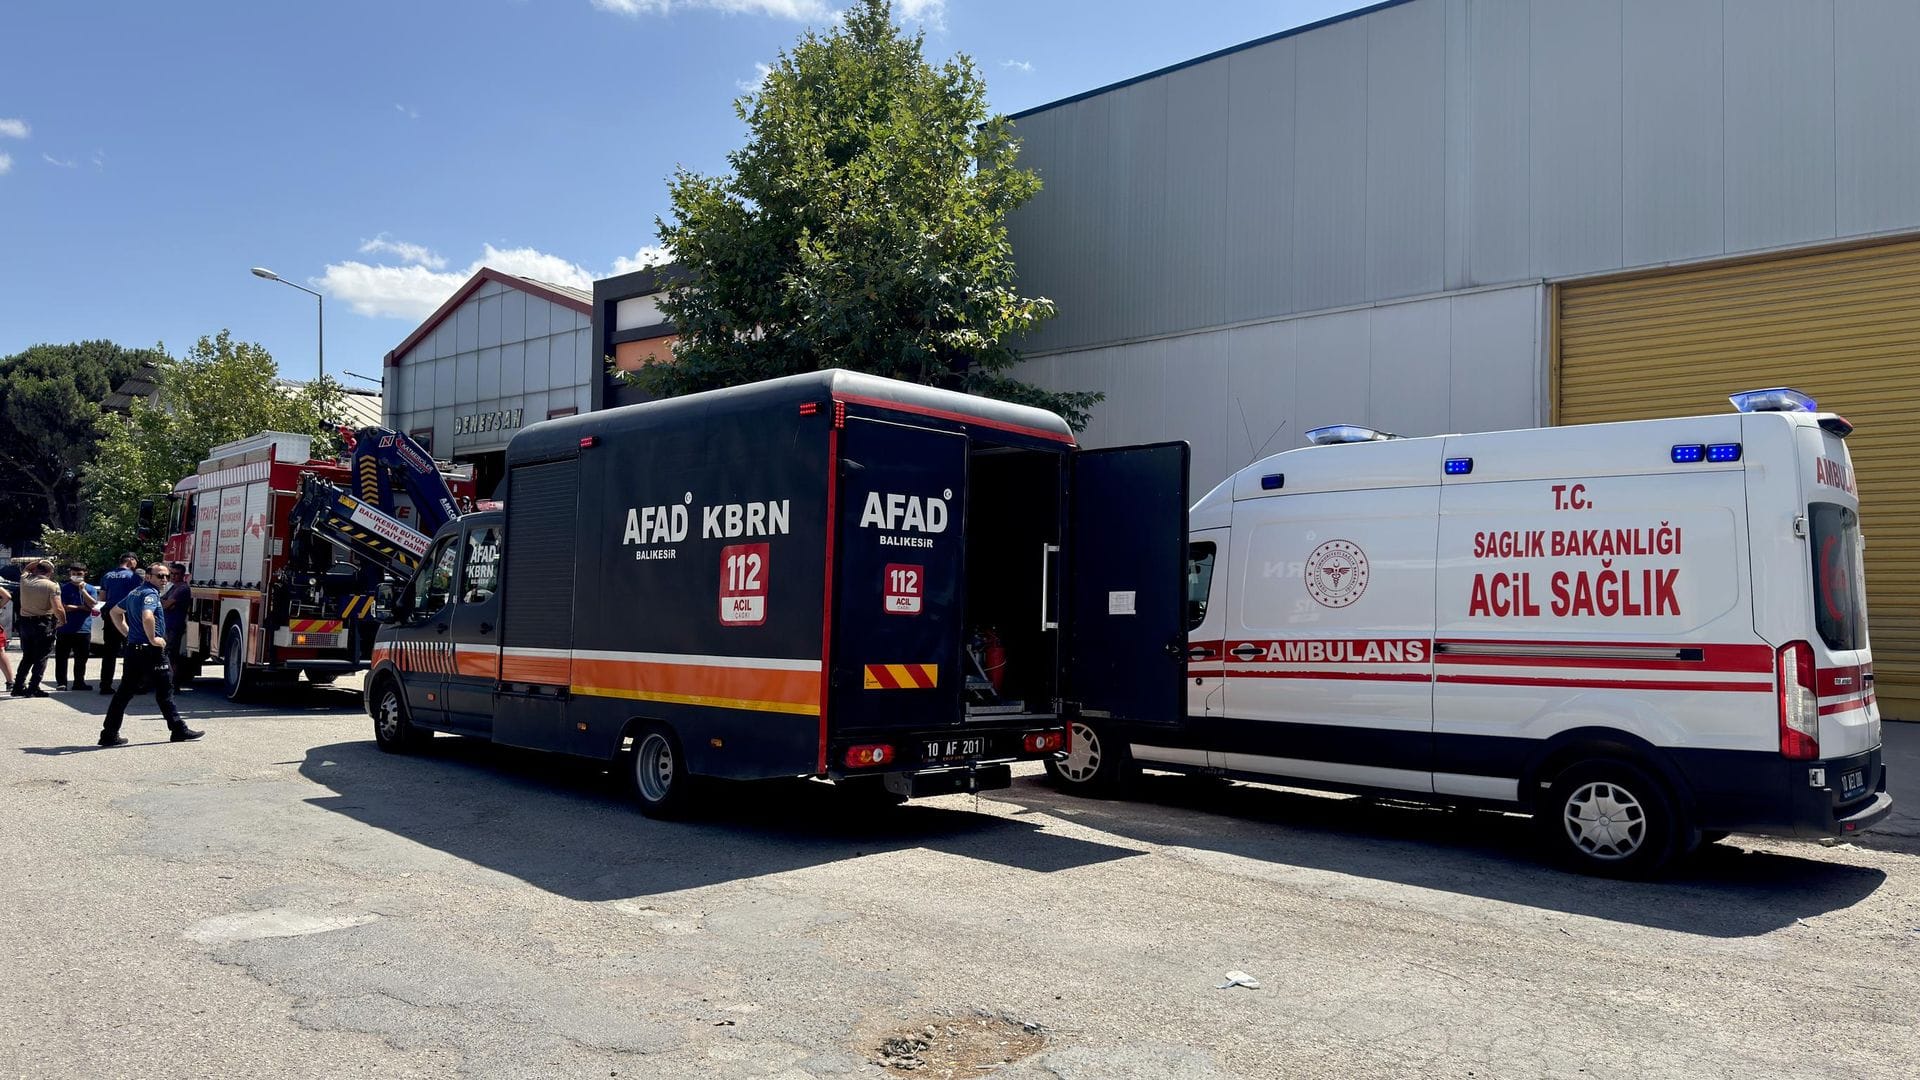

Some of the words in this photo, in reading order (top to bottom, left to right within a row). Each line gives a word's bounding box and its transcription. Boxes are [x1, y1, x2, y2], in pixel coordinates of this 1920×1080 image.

[454, 408, 523, 436] DENEYSAN
[1552, 484, 1592, 510] T.C.
[623, 504, 689, 545] AFAD
[702, 499, 790, 539] KBRN
[860, 491, 948, 533] AFAD
[1551, 521, 1681, 557] BAKANLIĞI
[470, 545, 497, 563] AFAD
[468, 565, 494, 578] KBRN
[727, 553, 762, 591] 112
[891, 570, 917, 593] 112
[1551, 559, 1681, 617] SAĞLIK
[1266, 640, 1424, 662] AMBULANS
[928, 743, 939, 757] 10
[946, 741, 958, 756] AF
[963, 740, 979, 754] 201
